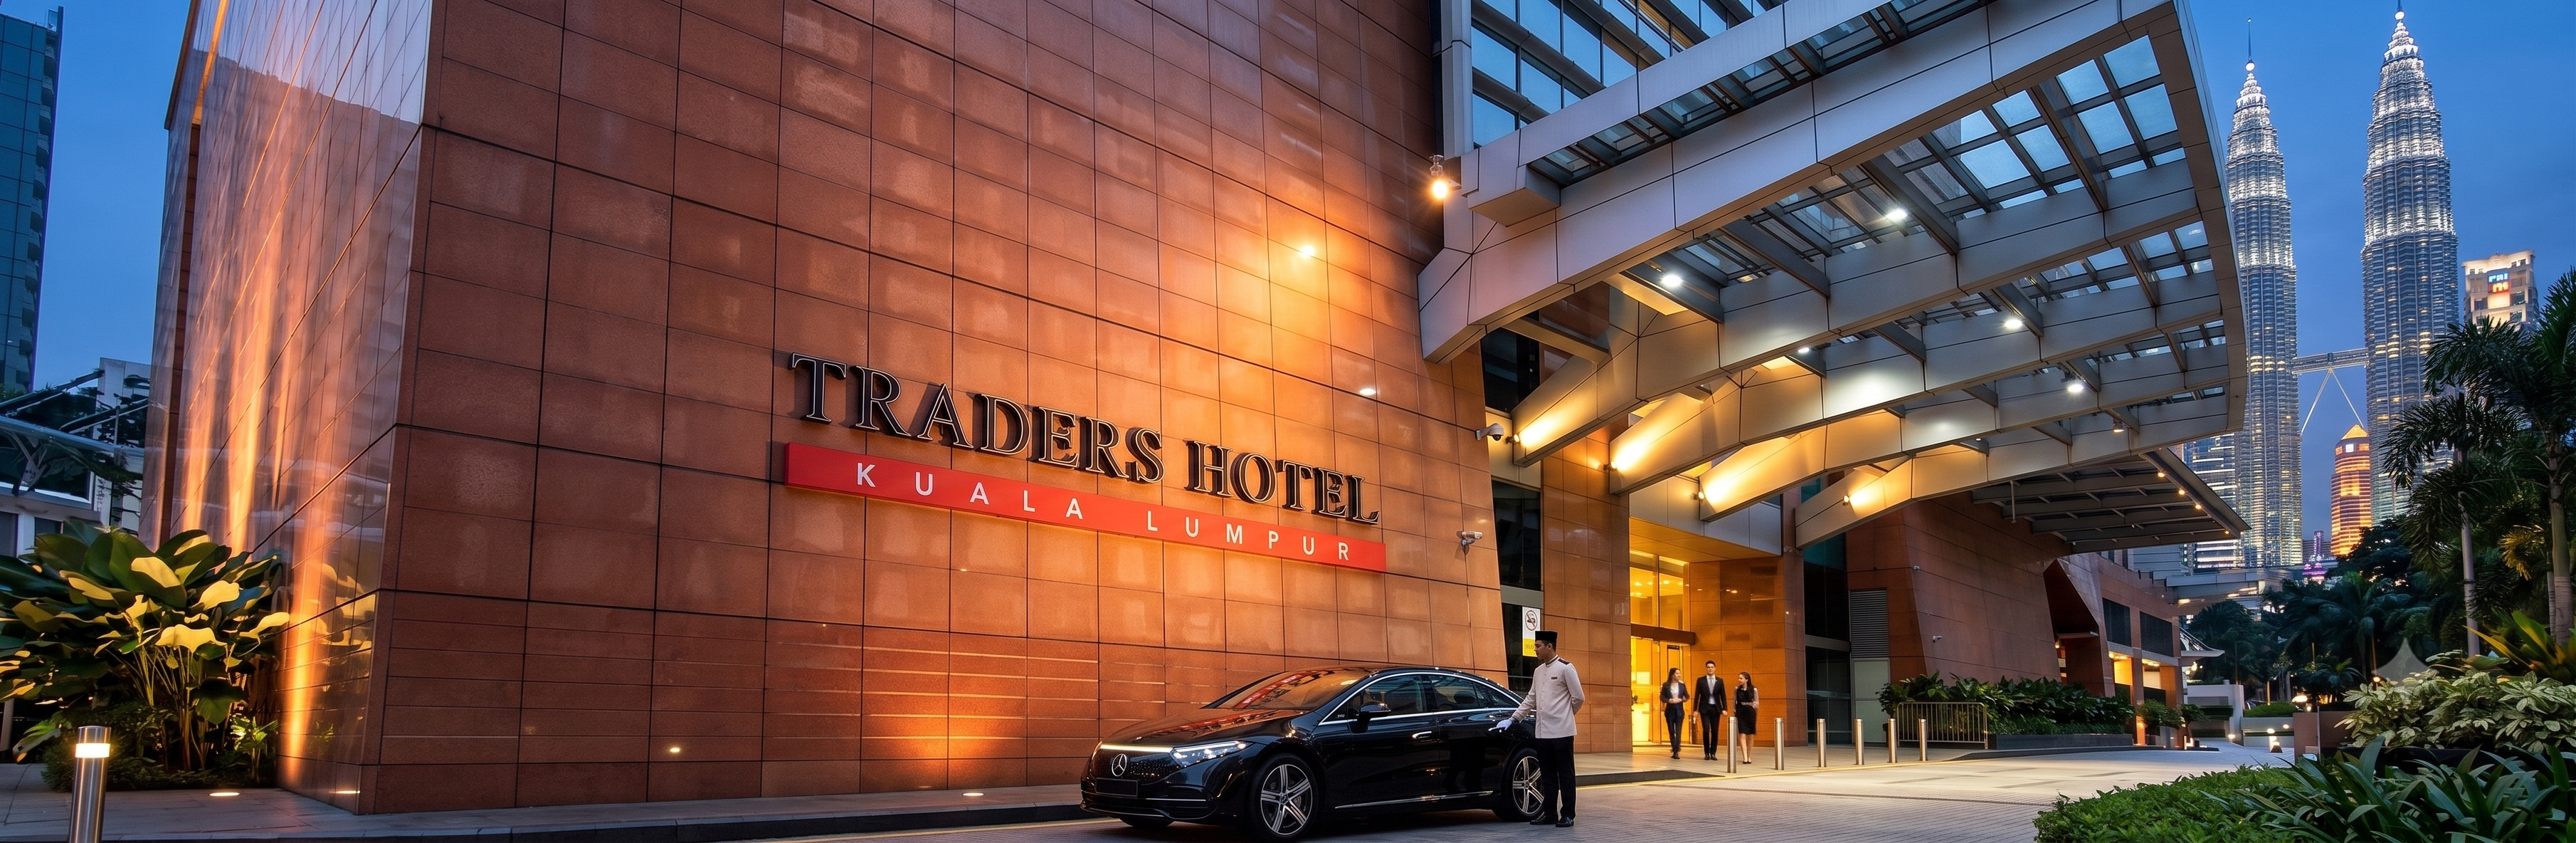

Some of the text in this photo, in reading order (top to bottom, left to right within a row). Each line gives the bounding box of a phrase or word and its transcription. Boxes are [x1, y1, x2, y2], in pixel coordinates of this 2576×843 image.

[790, 352, 1381, 525] TRADERS HOTEL
[856, 462, 1350, 561] KUALA LUMPUR
